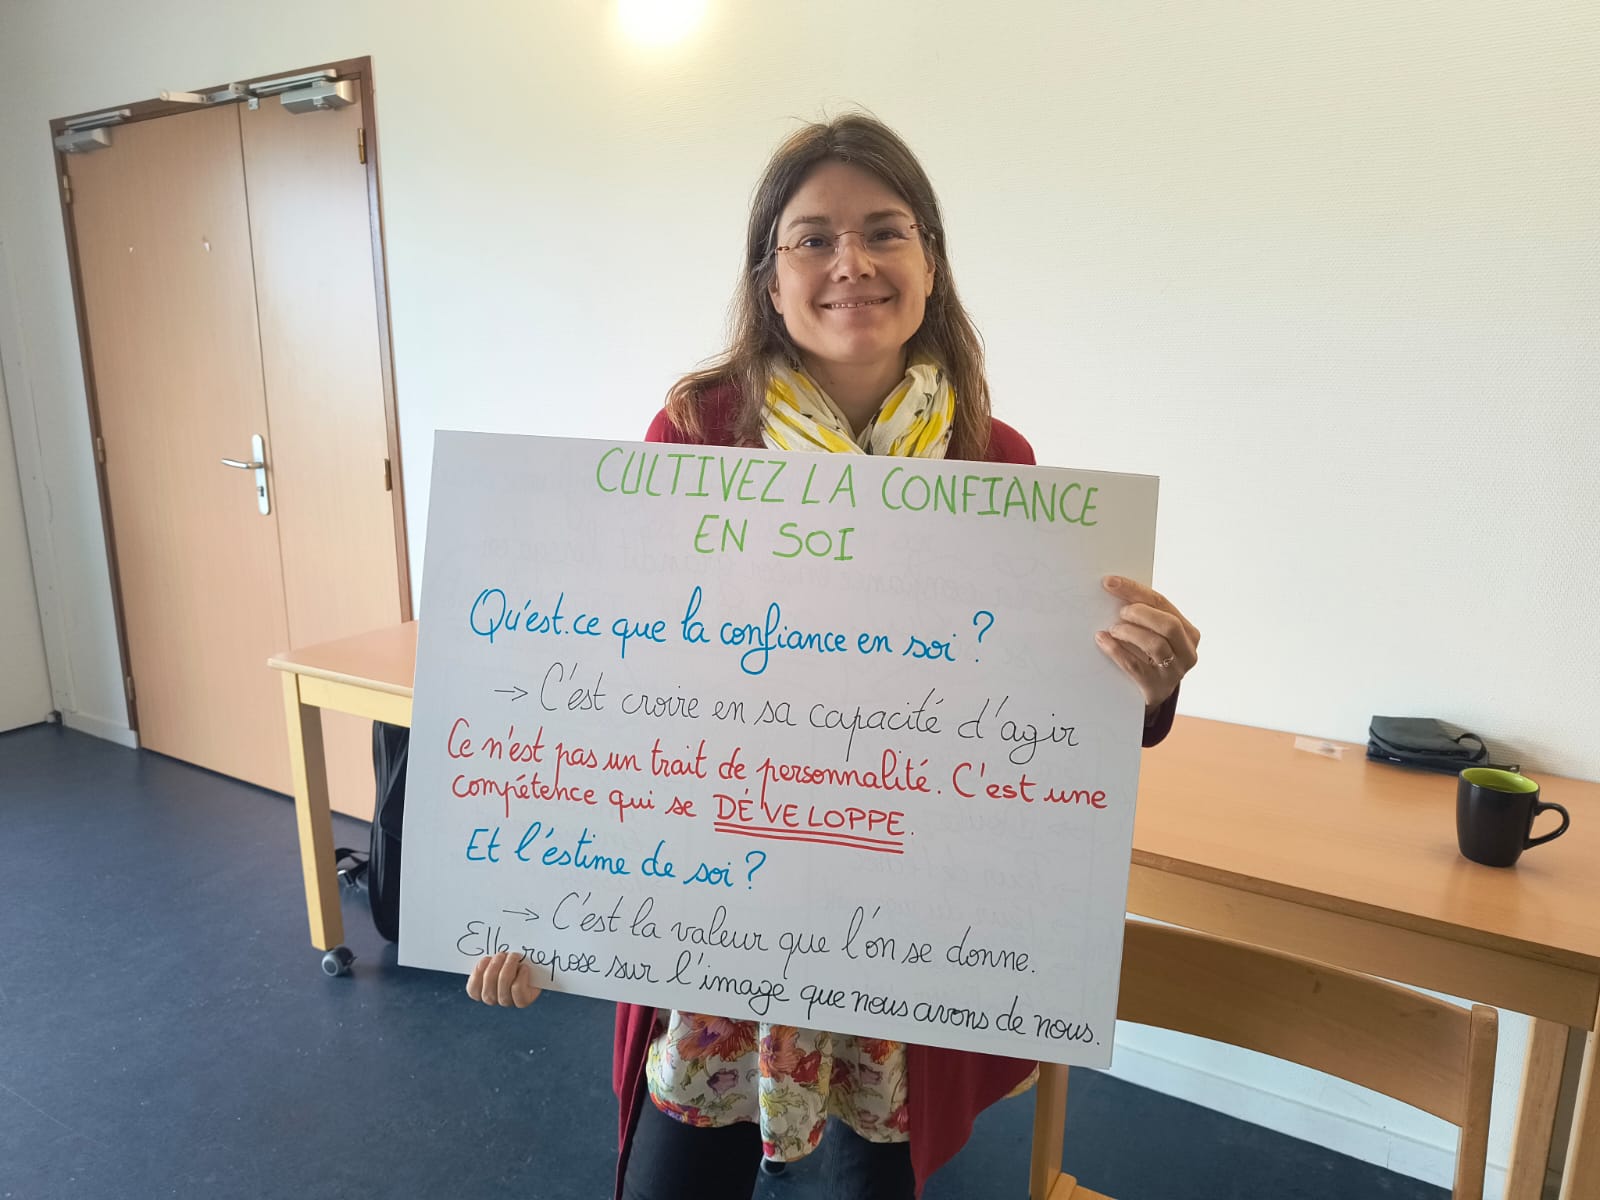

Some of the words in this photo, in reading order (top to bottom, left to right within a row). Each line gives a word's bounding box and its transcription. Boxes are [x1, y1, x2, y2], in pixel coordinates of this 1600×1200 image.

[597, 447, 787, 502] CULTIVEZ
[801, 463, 856, 508] LA
[881, 466, 1099, 527] CONFIANCE
[694, 514, 748, 553] EN
[772, 522, 855, 561] SOI
[612, 617, 666, 659] que
[681, 586, 710, 645] la
[720, 602, 848, 676] confiance
[857, 632, 893, 654] en
[902, 634, 956, 662] soi
[540, 662, 606, 711] C'est
[621, 686, 700, 719] croire
[711, 700, 746, 721] en
[753, 701, 797, 726] sa
[809, 688, 943, 762] capacité
[957, 696, 1079, 765] d'agir
[448, 718, 474, 758] Ce
[481, 725, 545, 763] n'est
[554, 742, 598, 790] pas
[602, 750, 642, 772] un
[651, 738, 707, 779] trait
[718, 747, 748, 780] de
[952, 762, 1037, 802] C'est
[1043, 787, 1107, 809] une
[452, 773, 598, 818] compétence
[608, 790, 656, 823] qui
[665, 796, 697, 817] se
[466, 826, 501, 862] Et
[641, 840, 676, 878] de
[683, 862, 734, 888] soi
[552, 892, 622, 933] C'est
[630, 897, 661, 939] la
[671, 905, 768, 952] valeur
[778, 932, 830, 980] que
[841, 906, 896, 961] l'on
[901, 943, 932, 965] se
[946, 926, 1036, 973] donne.
[518, 945, 600, 982] repose
[604, 955, 659, 983] sur
[666, 950, 790, 1016] l'image
[800, 985, 846, 1020] que
[850, 990, 908, 1017] nous
[913, 1001, 989, 1032] avons
[996, 995, 1026, 1035] de
[1034, 1014, 1102, 1046] nous.
